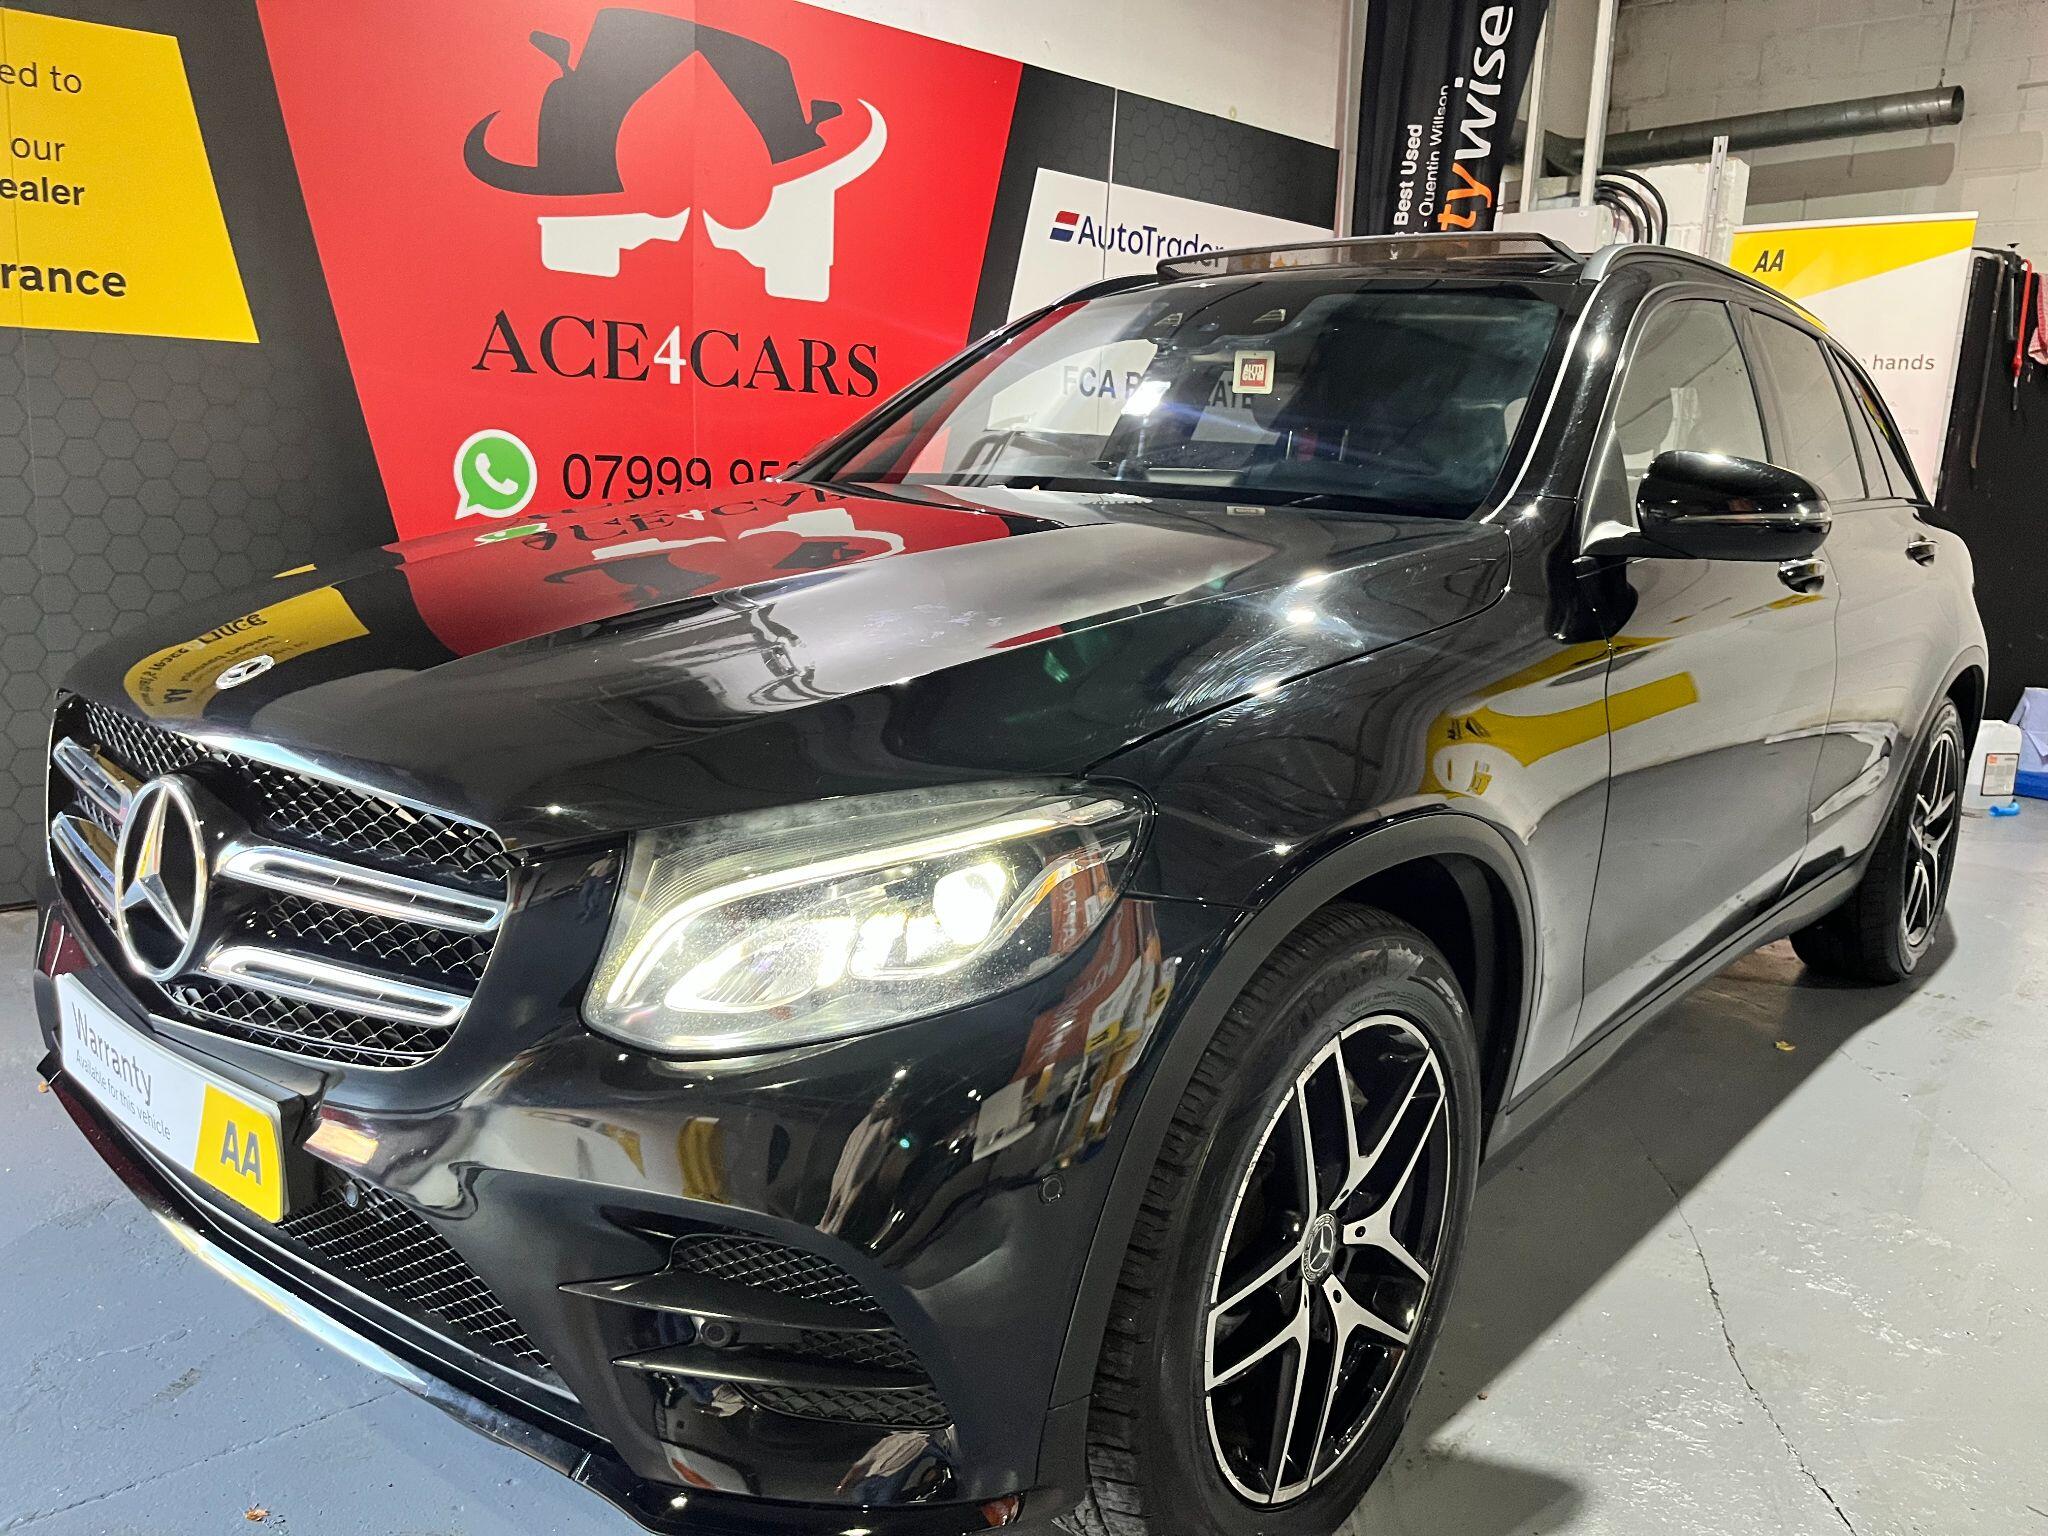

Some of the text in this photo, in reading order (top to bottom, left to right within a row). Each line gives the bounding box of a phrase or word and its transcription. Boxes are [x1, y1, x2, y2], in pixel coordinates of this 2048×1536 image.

[49, 65, 82, 93] to
[11, 137, 67, 162] our
[1400, 124, 1423, 175] Used
[1418, 151, 1441, 216] Quentin
[1430, 85, 1449, 146] Willson
[0, 177, 85, 205] ealer
[1393, 180, 1415, 226] Best
[1, 263, 127, 298] rance
[1752, 249, 1785, 273] AA
[471, 309, 880, 398] ACE4CARS
[1872, 354, 1936, 371] hands
[1063, 366, 1117, 399] FCA
[562, 453, 713, 501] 07999
[71, 1001, 152, 1107] Warranty
[76, 1049, 171, 1140] Available for this vehicle
[220, 1119, 262, 1186] AA
